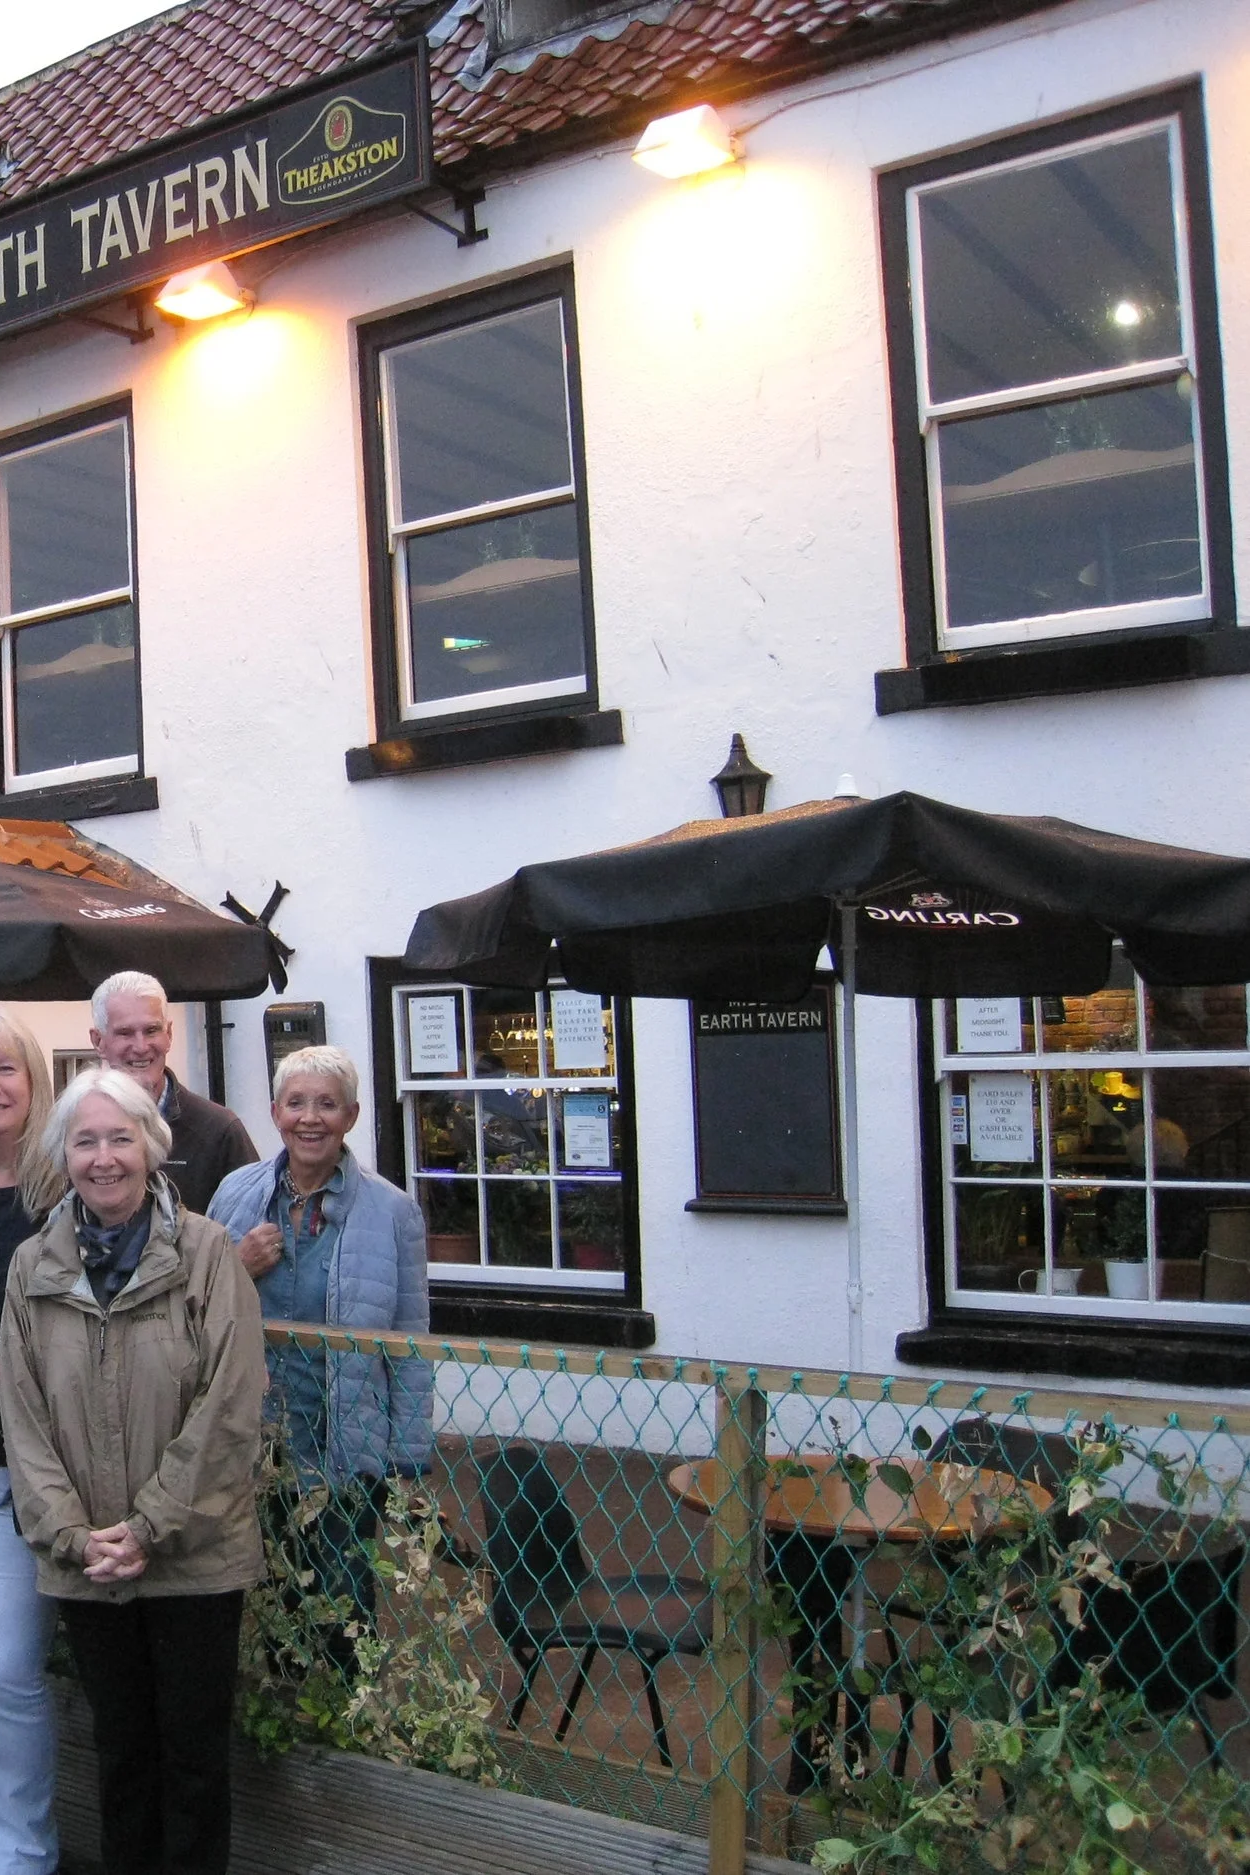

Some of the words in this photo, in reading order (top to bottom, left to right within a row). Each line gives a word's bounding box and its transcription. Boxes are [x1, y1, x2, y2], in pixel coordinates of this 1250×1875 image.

[283, 136, 398, 193] THEAKSTON
[308, 177, 352, 194] LEGENDARY
[353, 168, 372, 179] ALES
[70, 138, 270, 274] TAVERN
[700, 1013, 752, 1029] EARTH
[757, 1011, 822, 1028] TAVERN
